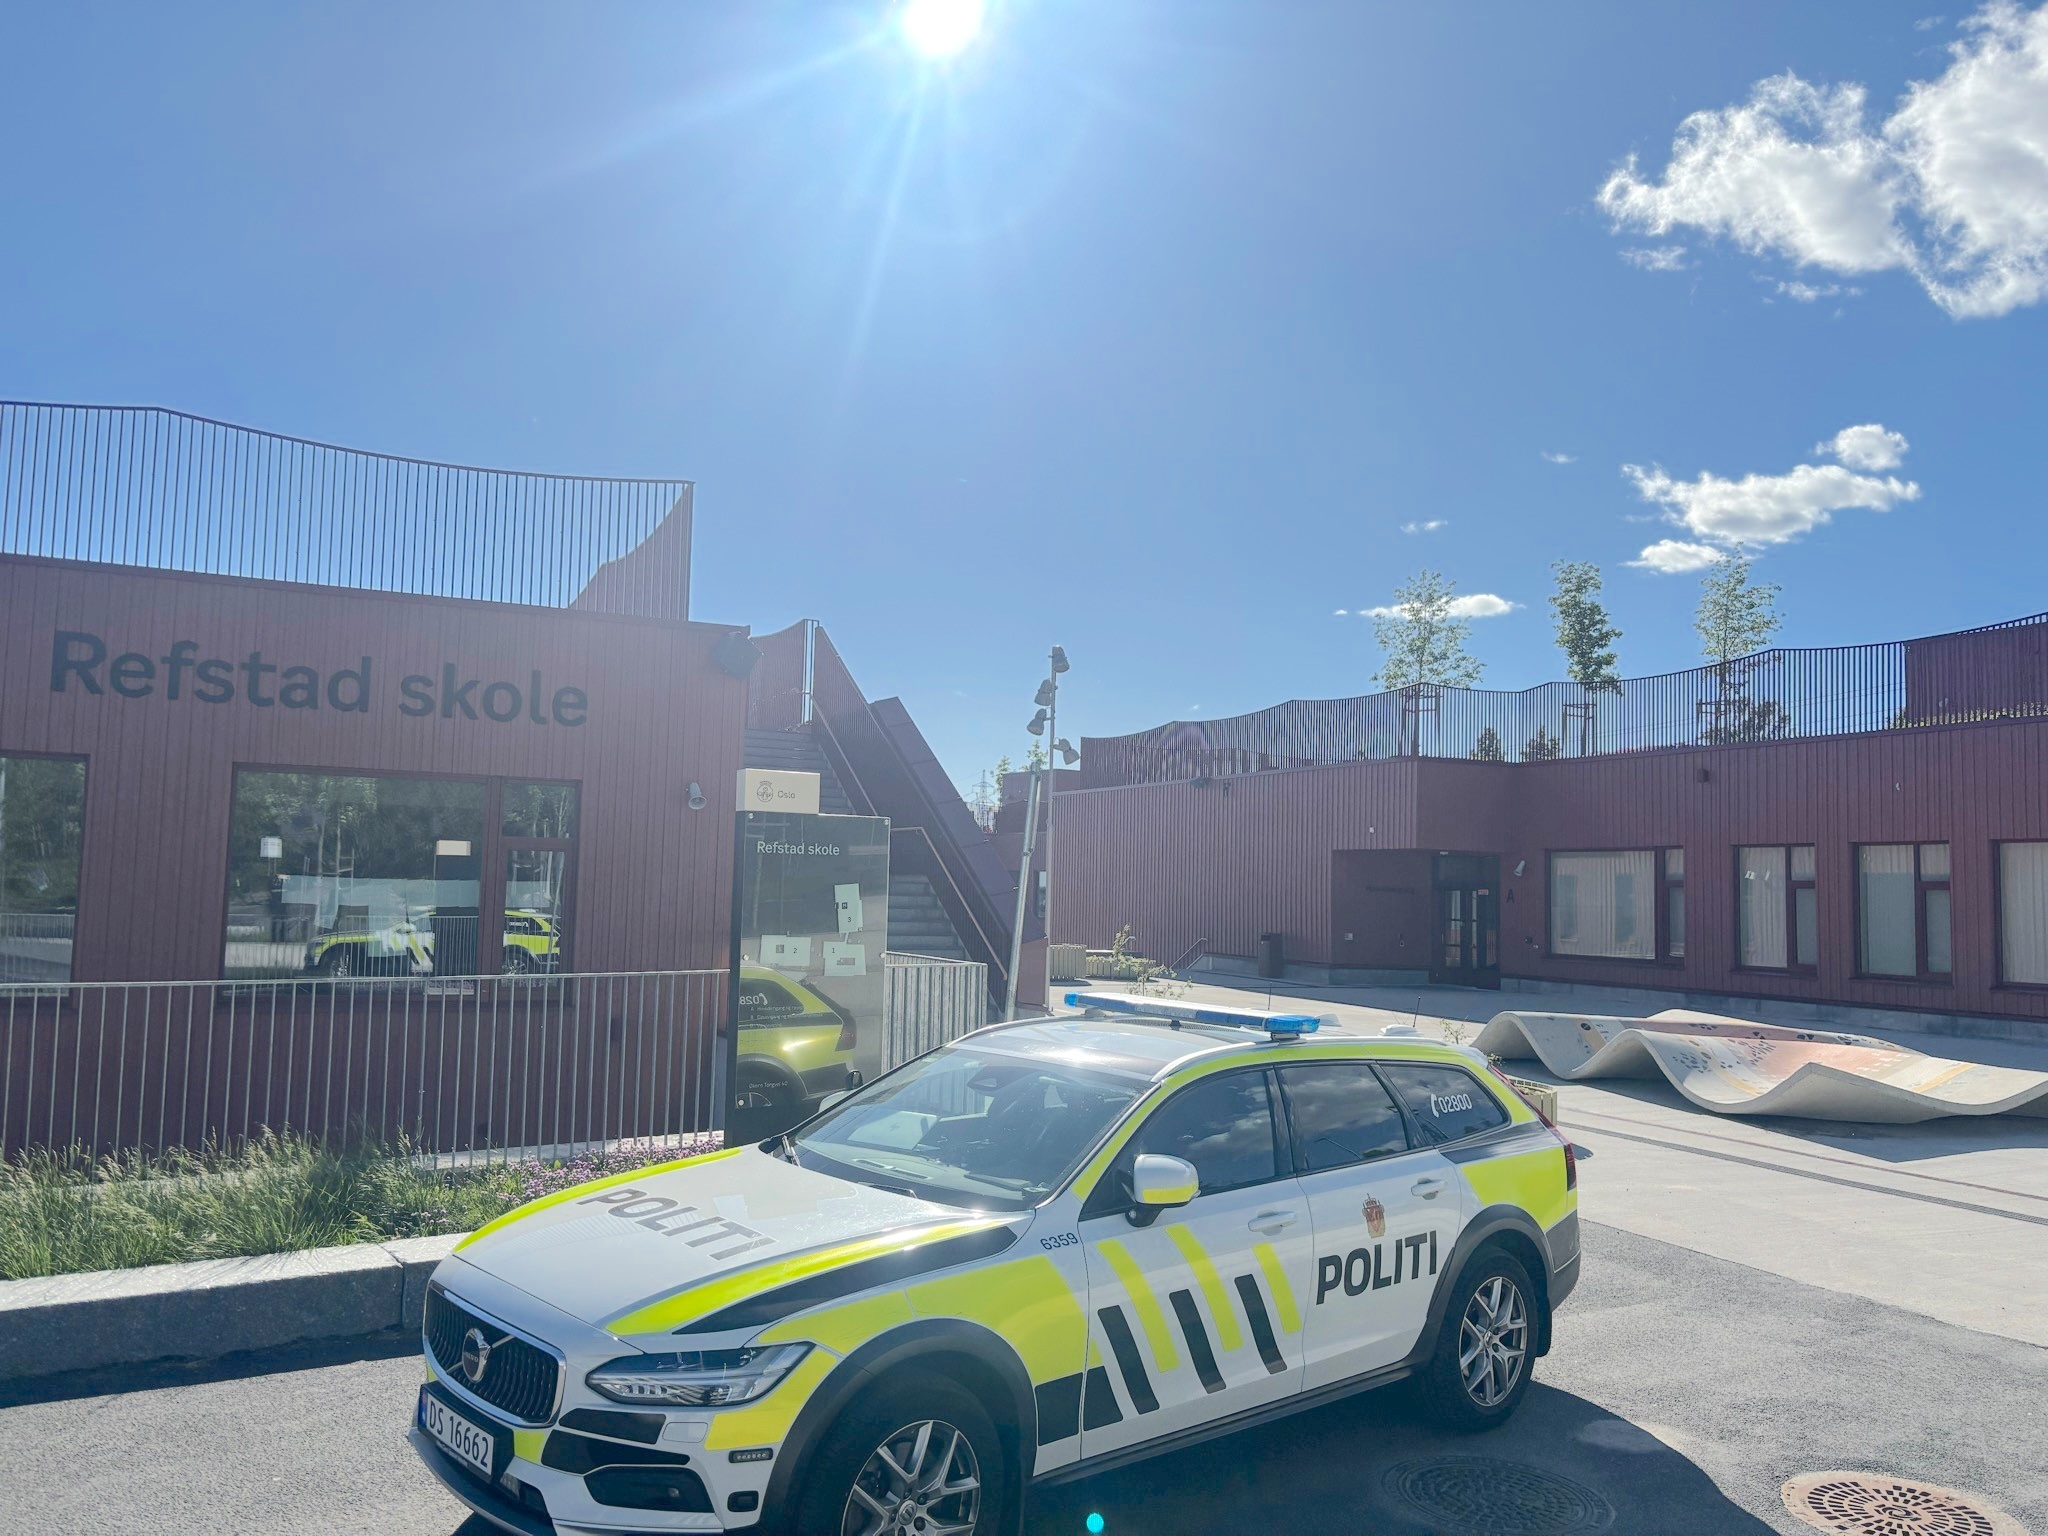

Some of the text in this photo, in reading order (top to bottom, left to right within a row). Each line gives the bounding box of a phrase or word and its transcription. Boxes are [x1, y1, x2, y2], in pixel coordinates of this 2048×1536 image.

[50, 630, 588, 727] Refstad skole
[777, 790, 796, 799] Oslo
[757, 841, 840, 856] Refstad skole
[1438, 1093, 1472, 1114] 02800
[577, 1188, 777, 1261] POLITI
[1040, 1231, 1079, 1251] 6359
[1316, 1231, 1437, 1305] POLITI
[429, 1400, 443, 1435] DS
[449, 1415, 489, 1467] 16662
